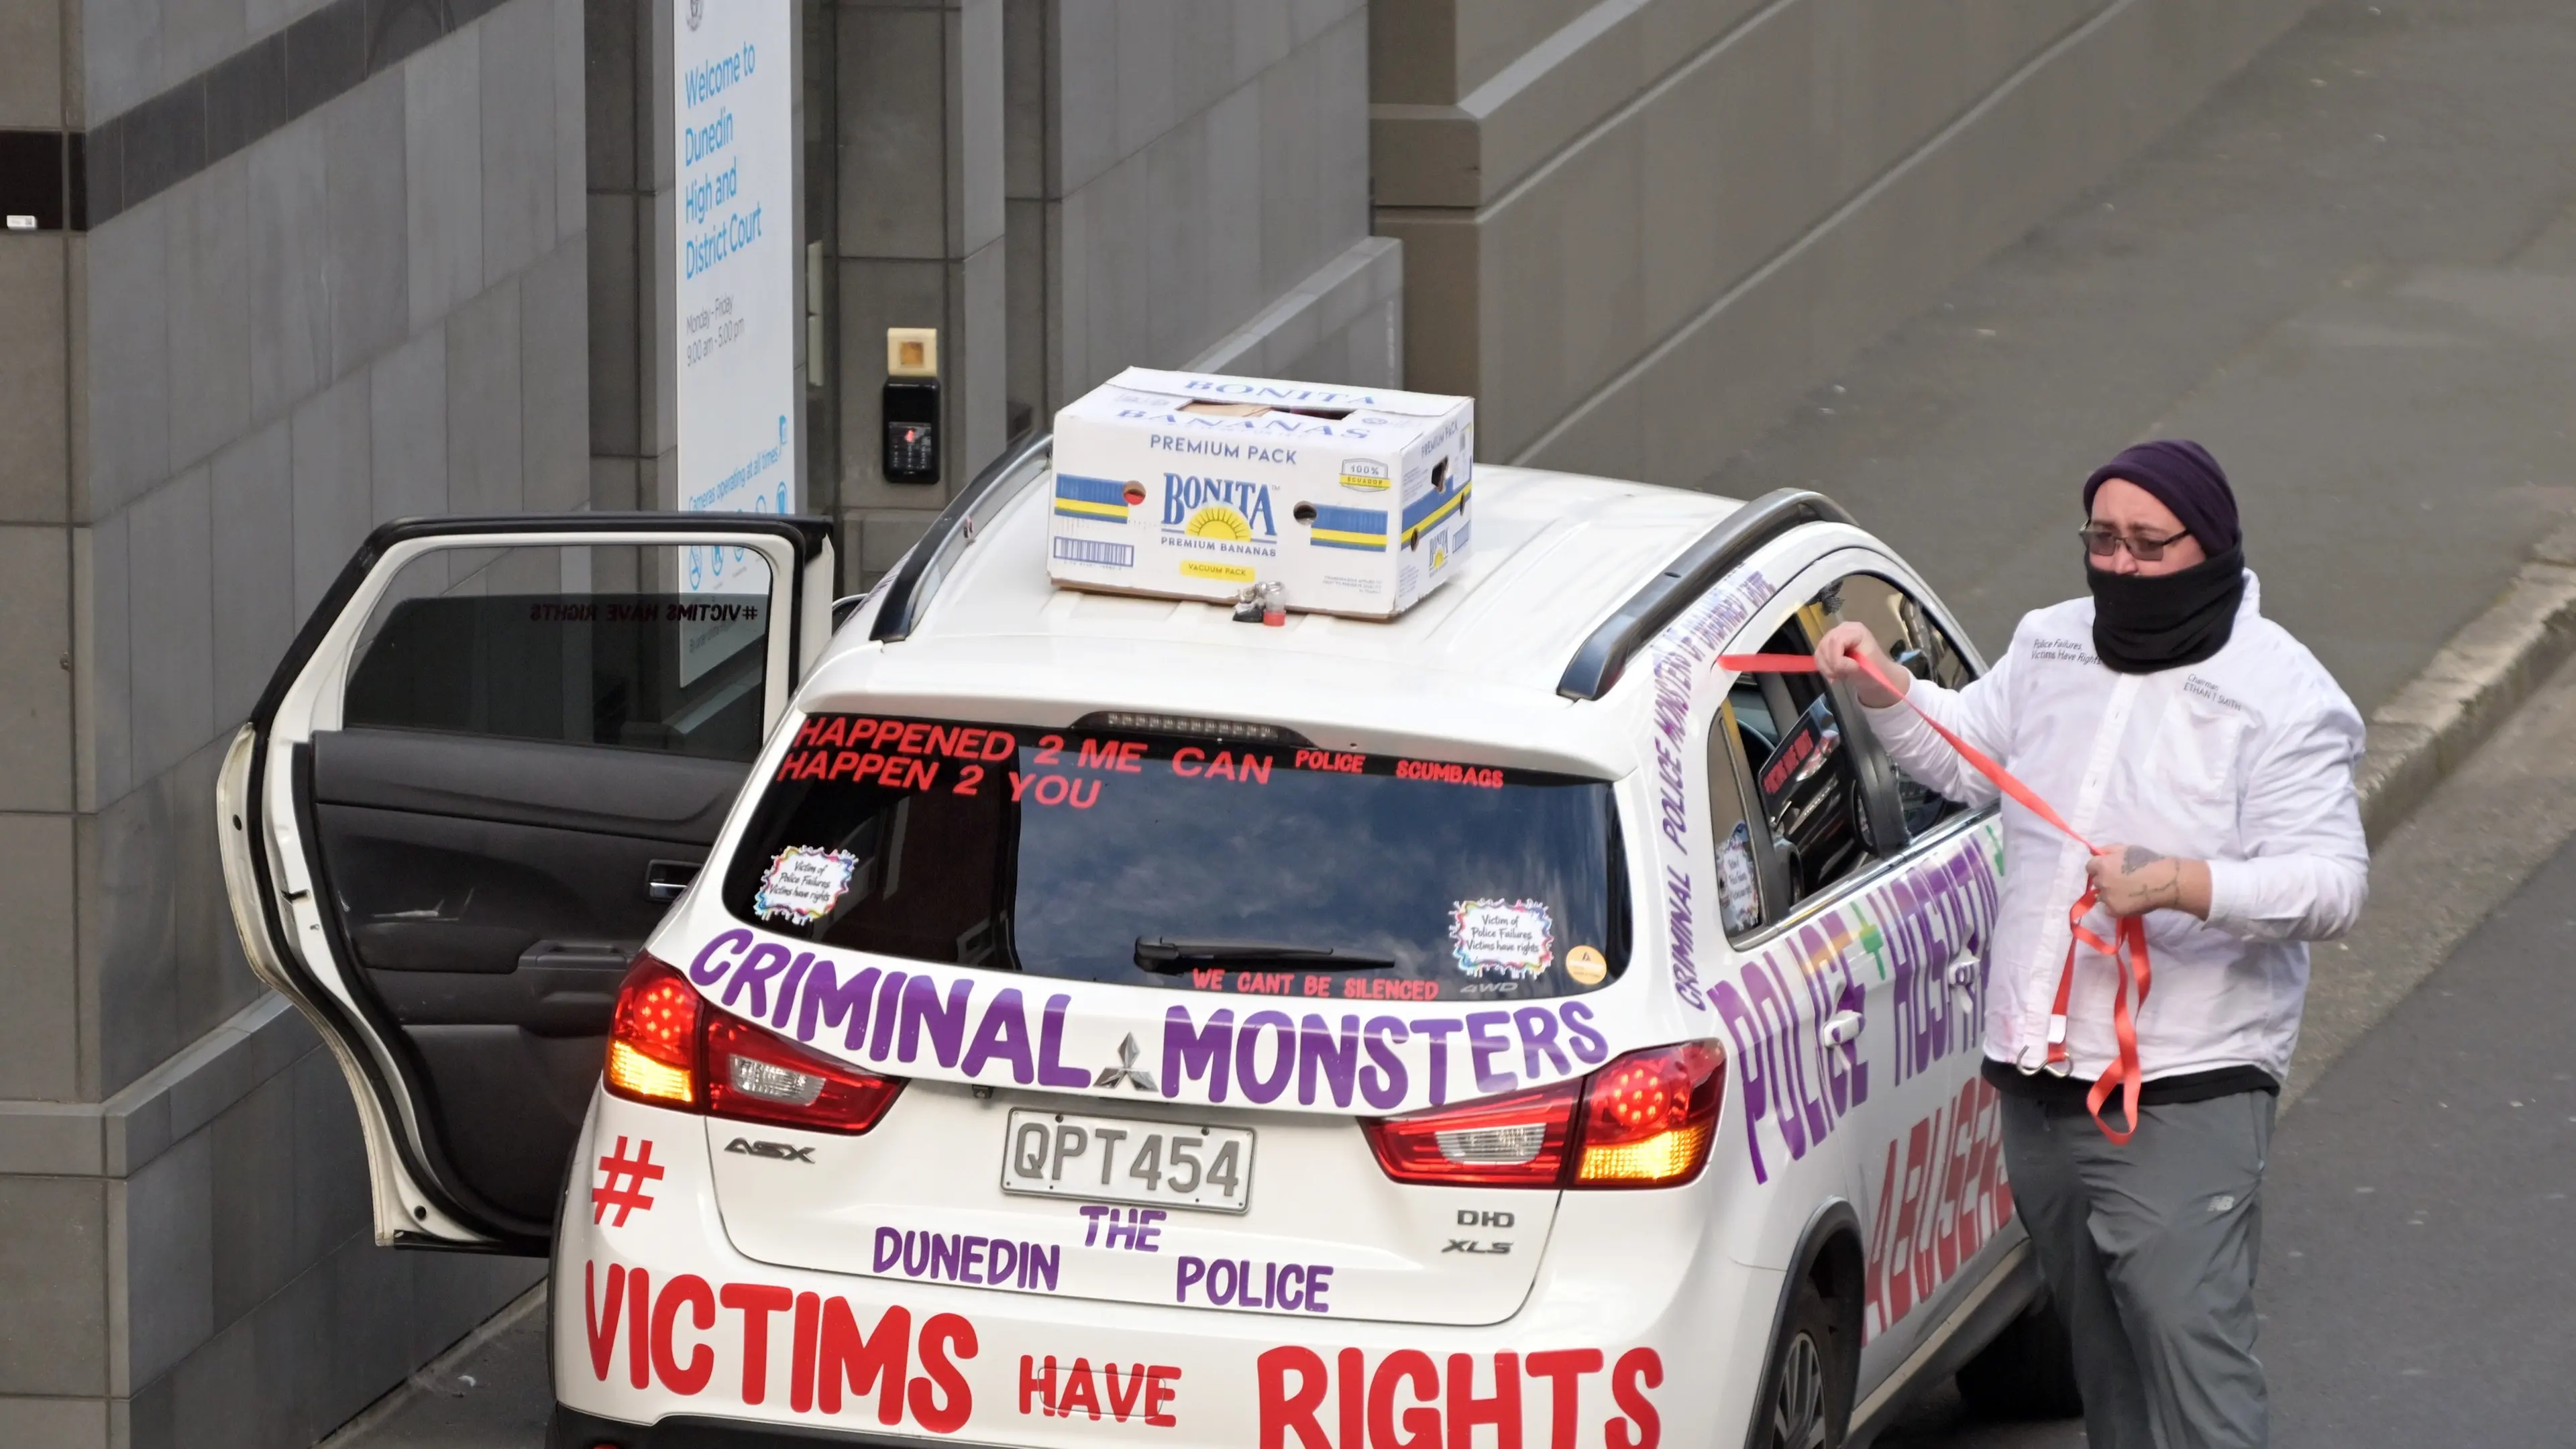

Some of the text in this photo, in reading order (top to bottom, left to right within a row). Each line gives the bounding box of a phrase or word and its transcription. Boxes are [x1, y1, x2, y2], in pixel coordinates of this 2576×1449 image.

[685, 41, 755, 109] Welcome to
[685, 107, 733, 167] Dunedin
[685, 156, 737, 225] High and
[686, 201, 762, 280] District Court
[686, 306, 711, 334] Monday
[714, 292, 734, 321] Friday
[703, 337, 713, 357] am
[734, 318, 745, 343] pm
[1184, 380, 1375, 405] BONITA
[1116, 409, 1370, 439] BANANAS
[1421, 431, 1444, 459] PREMIUM
[1444, 421, 1458, 440] PACK
[1150, 434, 1297, 465] PREMIUM PACK
[716, 468, 745, 500] operating
[762, 446, 778, 470] times
[1347, 476, 1383, 486] ECUADOR
[1350, 464, 1379, 475] 100%
[1161, 472, 1277, 536] BONITA
[1161, 536, 1277, 557] PREMIUM BANANAS
[1429, 527, 1449, 568] BONITA
[1188, 563, 1246, 576] VACUUM PACK
[2031, 650, 2055, 659] Victims
[2058, 649, 2076, 660] Have
[2033, 639, 2053, 649] Police
[2184, 682, 2211, 699] ETHAN
[2218, 695, 2241, 710] SMITH
[792, 716, 1273, 785] HAPPENED 2 ME CAN
[1295, 749, 1366, 773] POLICE
[777, 749, 1102, 809] HAPPEN 2 YOU
[1654, 736, 1688, 855] POLICE
[779, 872, 830, 889] Police Failures
[794, 861, 828, 876] Victim of
[769, 883, 830, 904] Victims have rights
[1471, 926, 1533, 939] Police Failures
[1482, 914, 1519, 930] Victim of
[1667, 864, 1706, 1011] CRIMINAL
[1466, 939, 1539, 955] Victims have rights
[1192, 968, 1439, 1000] WE CANT BE SILENCED
[1460, 982, 1518, 993] 4WD
[690, 928, 1609, 1110] CRIMINAL MONSTERS
[1707, 910, 1868, 1185] POLICE
[724, 1137, 816, 1165] ASX
[1014, 1122, 1240, 1197] QPT454
[592, 1136, 664, 1228] #
[1079, 1206, 1167, 1252] THE
[1441, 1238, 1514, 1254] XLS
[873, 1226, 1060, 1291] DUNEDIN
[1177, 1256, 1334, 1313] POLICE
[585, 1259, 1664, 1449] VICTIMS HAVE RIGHTS
